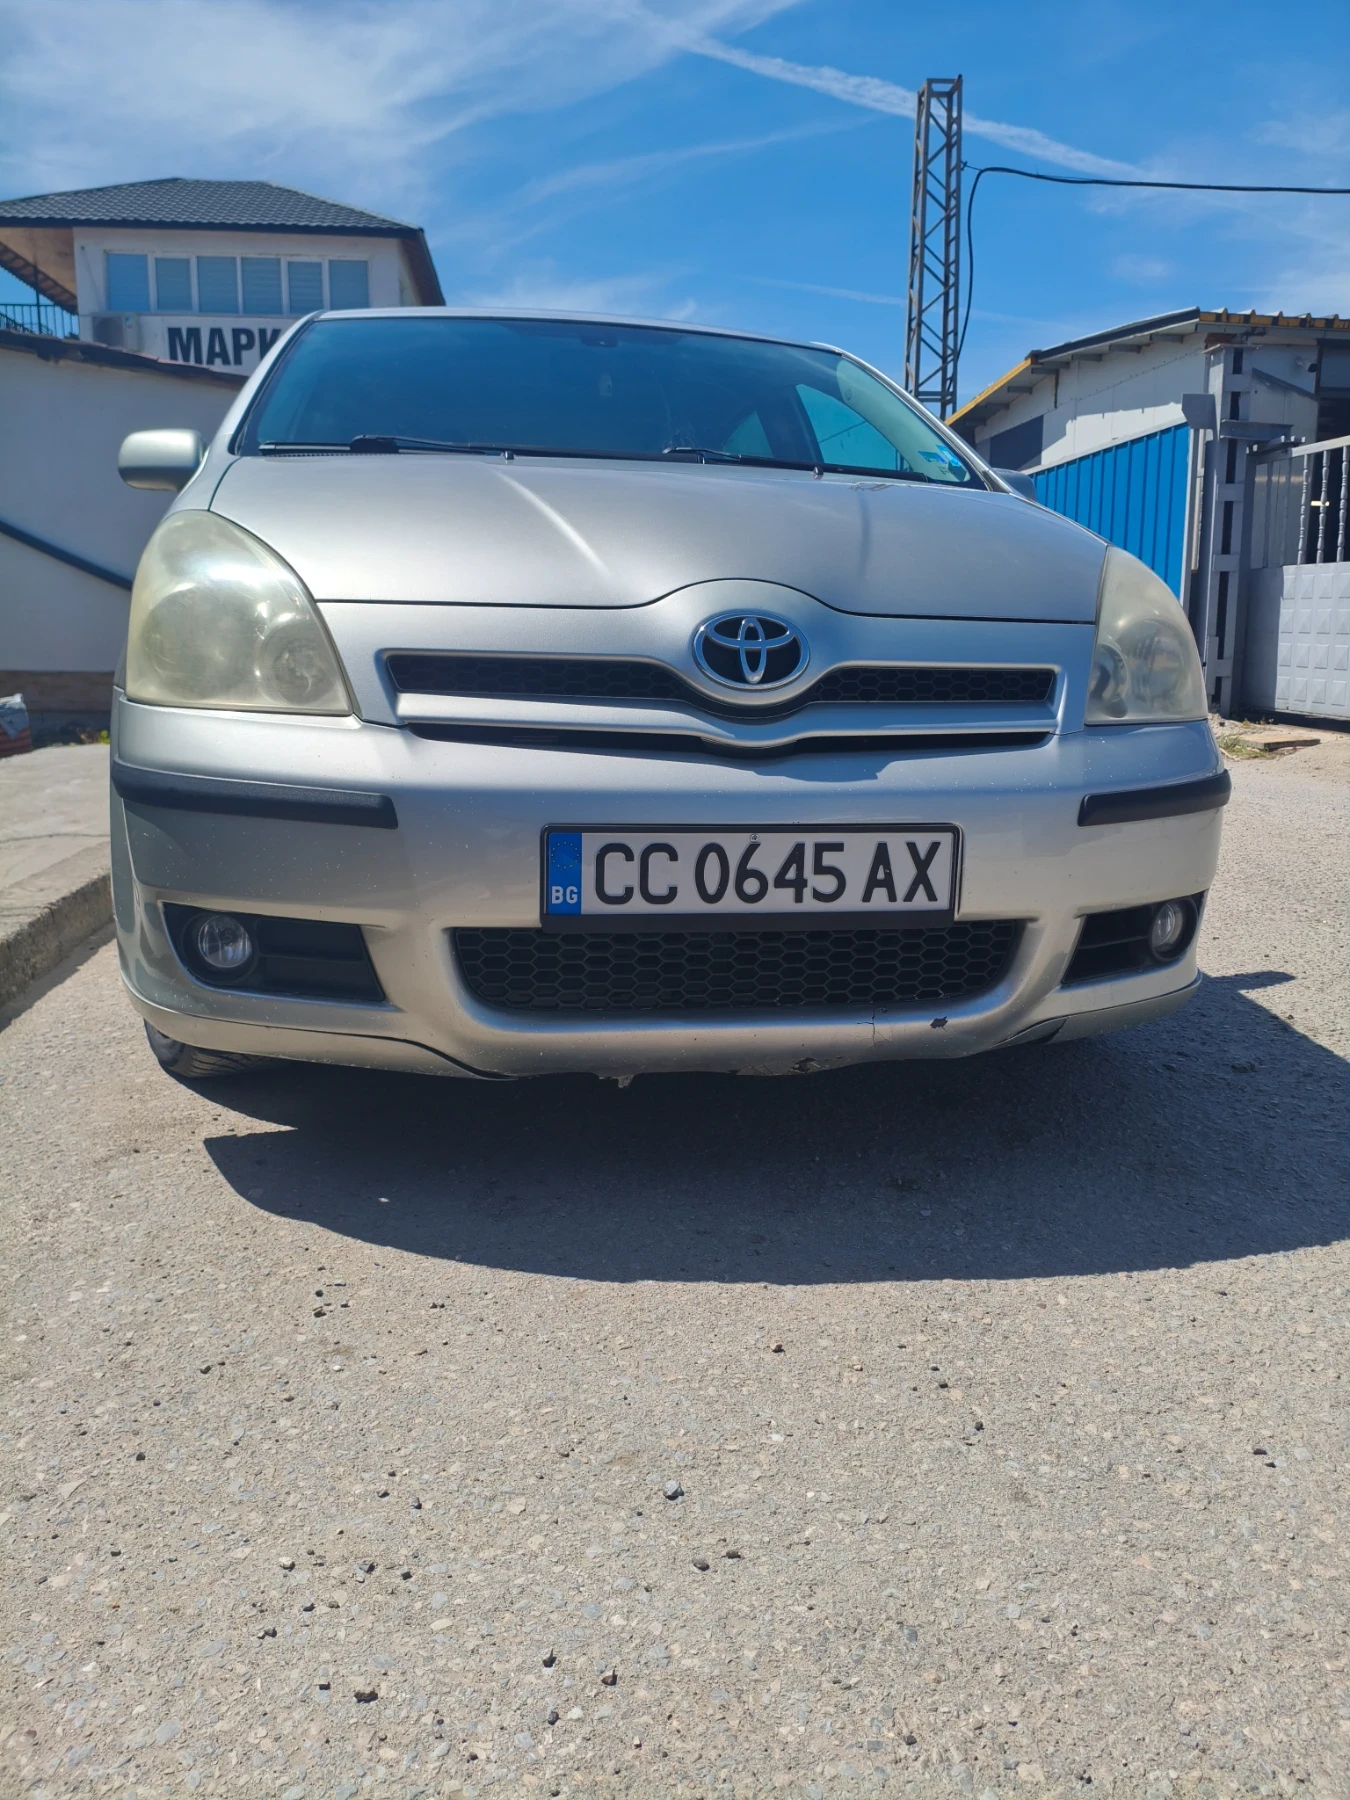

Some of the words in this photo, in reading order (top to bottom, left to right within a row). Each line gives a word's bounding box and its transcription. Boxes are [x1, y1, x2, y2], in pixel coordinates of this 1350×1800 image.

[595, 843, 678, 905] CC
[694, 841, 847, 904] 0645
[862, 842, 941, 903] AX
[551, 886, 578, 904] BG
